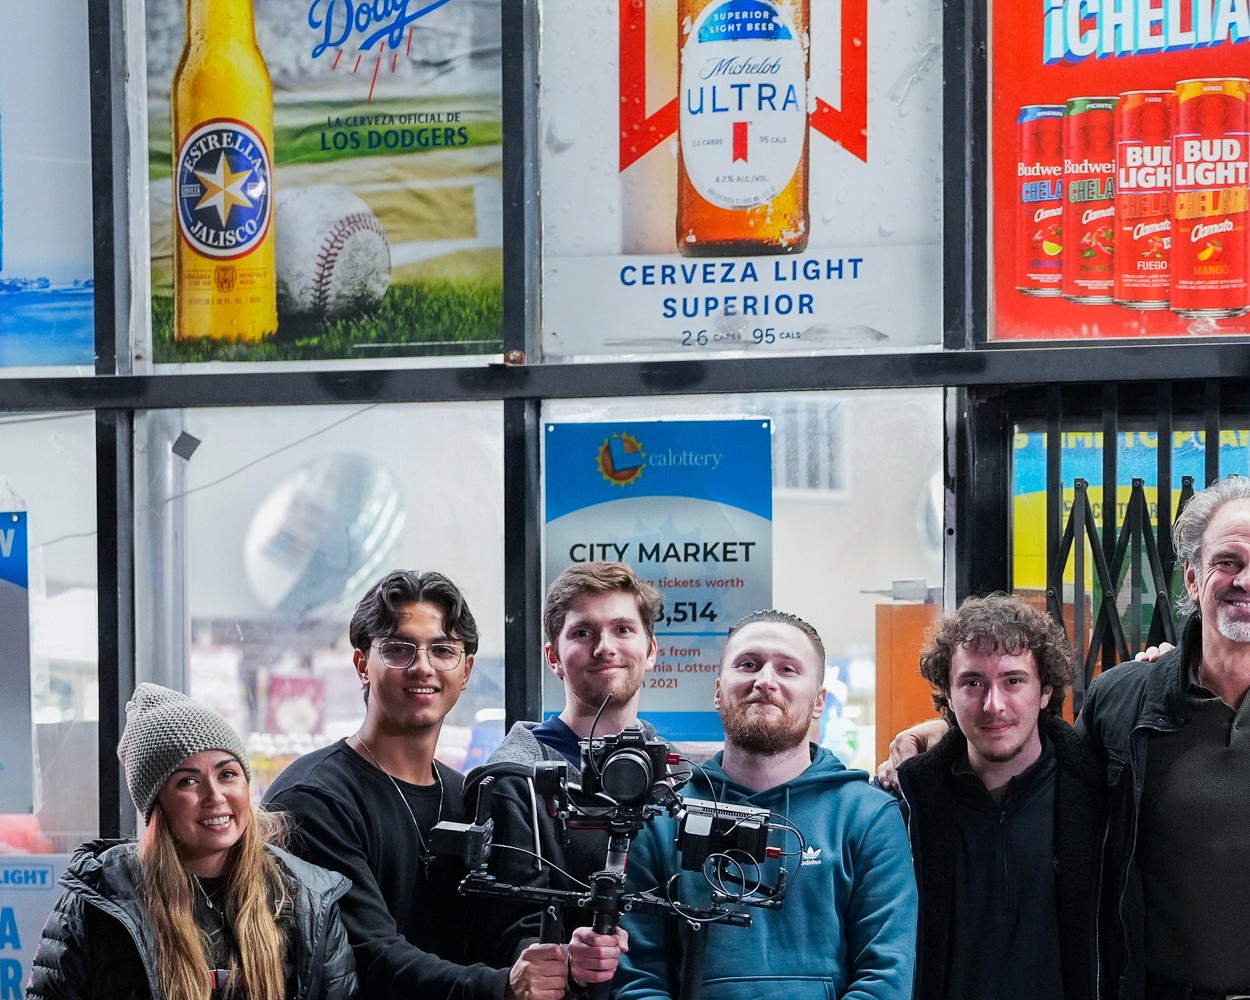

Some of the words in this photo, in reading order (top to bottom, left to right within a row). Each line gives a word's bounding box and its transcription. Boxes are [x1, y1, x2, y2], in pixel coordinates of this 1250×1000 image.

[713, 10, 771, 22] SUPERIOR
[709, 23, 742, 34] LIGHT
[746, 22, 775, 32] BEER
[700, 56, 783, 80] Michelob
[687, 83, 800, 116] ULTRA
[327, 116, 342, 128] LA
[345, 114, 395, 127] CERVEZA
[399, 112, 442, 125] OFICIAL
[446, 112, 461, 123] DE
[320, 131, 361, 150] LOS
[368, 126, 469, 149] DODGERS
[183, 132, 263, 175] ESTRELLA
[1183, 138, 1241, 163] BUD
[1175, 161, 1249, 186] LIGHT
[190, 218, 258, 247] JALISCO
[1190, 219, 1234, 243] Clamato
[620, 261, 759, 287] CERVEZA
[774, 258, 863, 282] LIGHT
[1136, 260, 1168, 271] FUEGO
[1194, 265, 1230, 275] MANGO
[662, 293, 815, 319] SUPERIOR
[752, 328, 776, 345] 95
[779, 331, 801, 340] CALS
[649, 448, 722, 470] calottery
[569, 542, 632, 563] CITY
[638, 541, 756, 563] MARKET
[658, 577, 701, 588] tickets
[705, 577, 744, 588] worth
[669, 646, 701, 657] from
[650, 678, 679, 689] 2021
[801, 859, 822, 867] adidas
